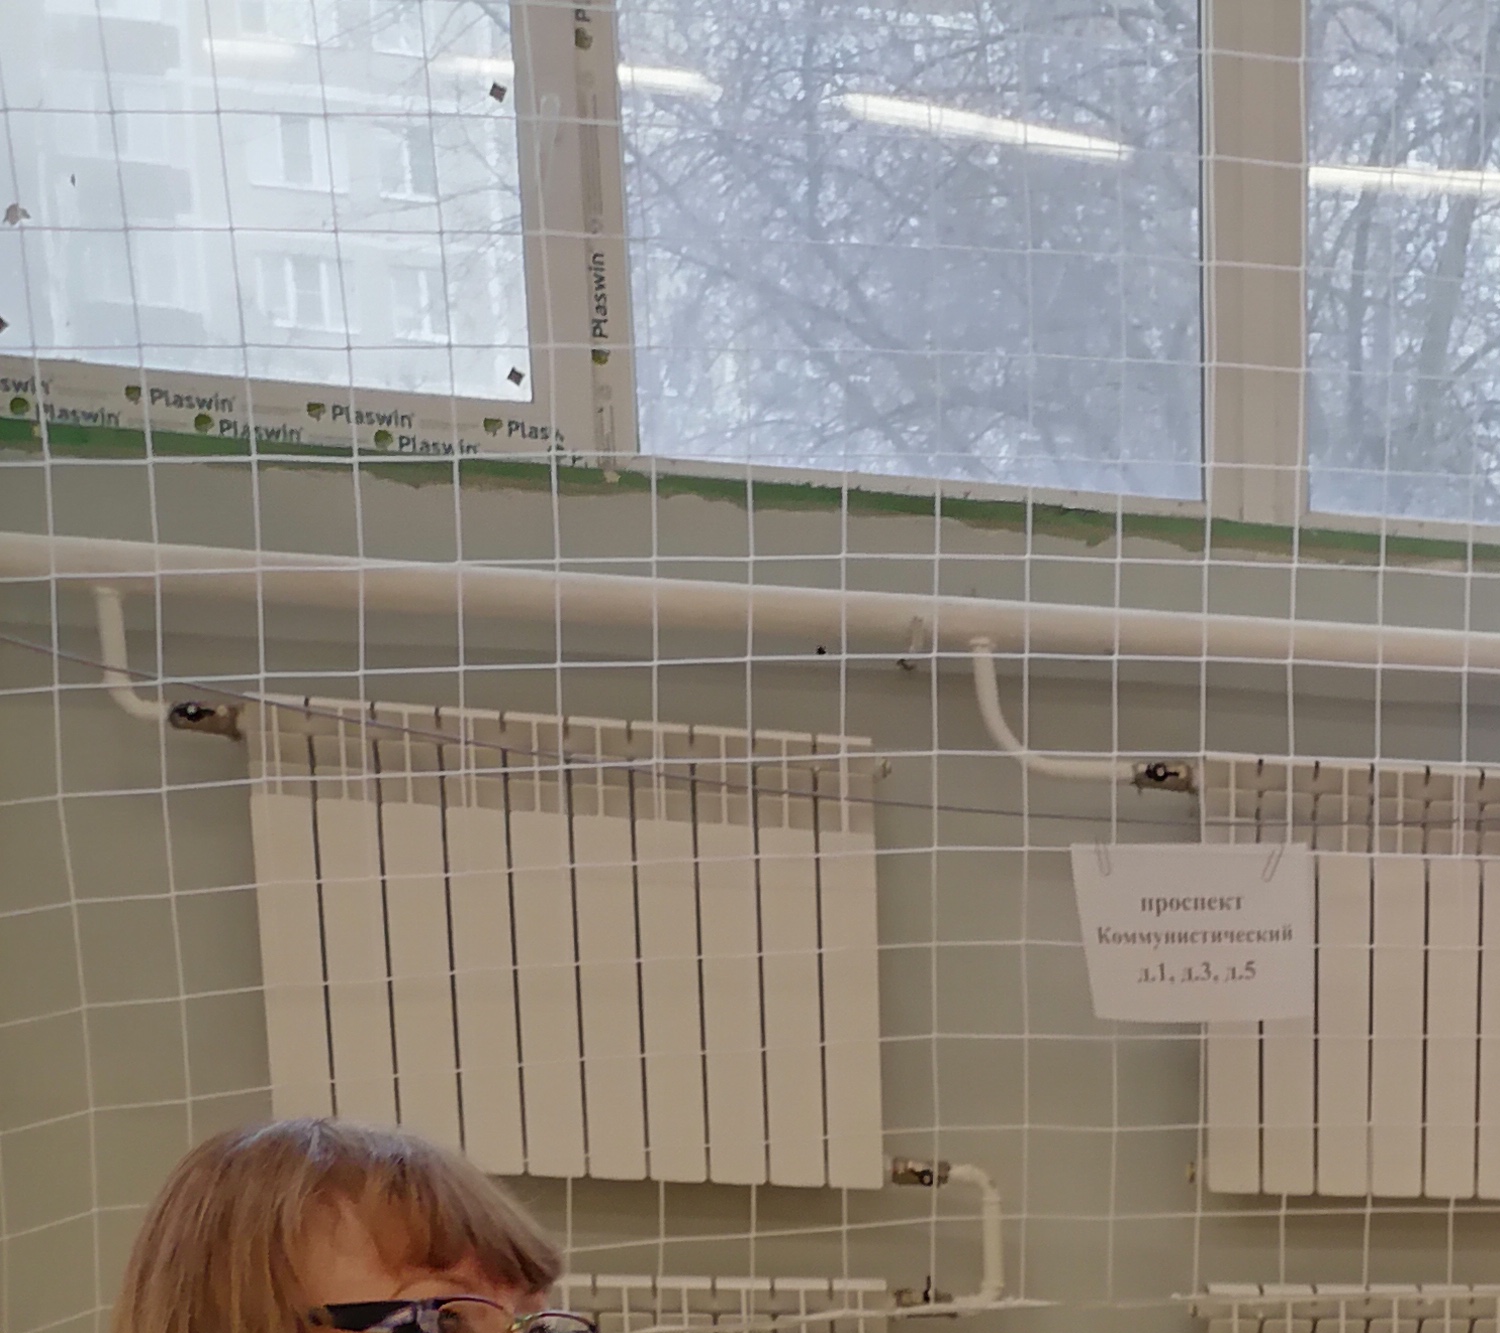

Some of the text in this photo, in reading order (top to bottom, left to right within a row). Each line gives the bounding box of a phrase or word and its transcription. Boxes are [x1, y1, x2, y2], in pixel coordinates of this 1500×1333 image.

[591, 252, 609, 339] Plaswin
[149, 388, 236, 413] Plaswin
[331, 404, 414, 429] Plaswin
[1140, 897, 1243, 917] проспект
[1097, 924, 1293, 949] Коммунистический
[1225, 960, 1256, 982] д.5
